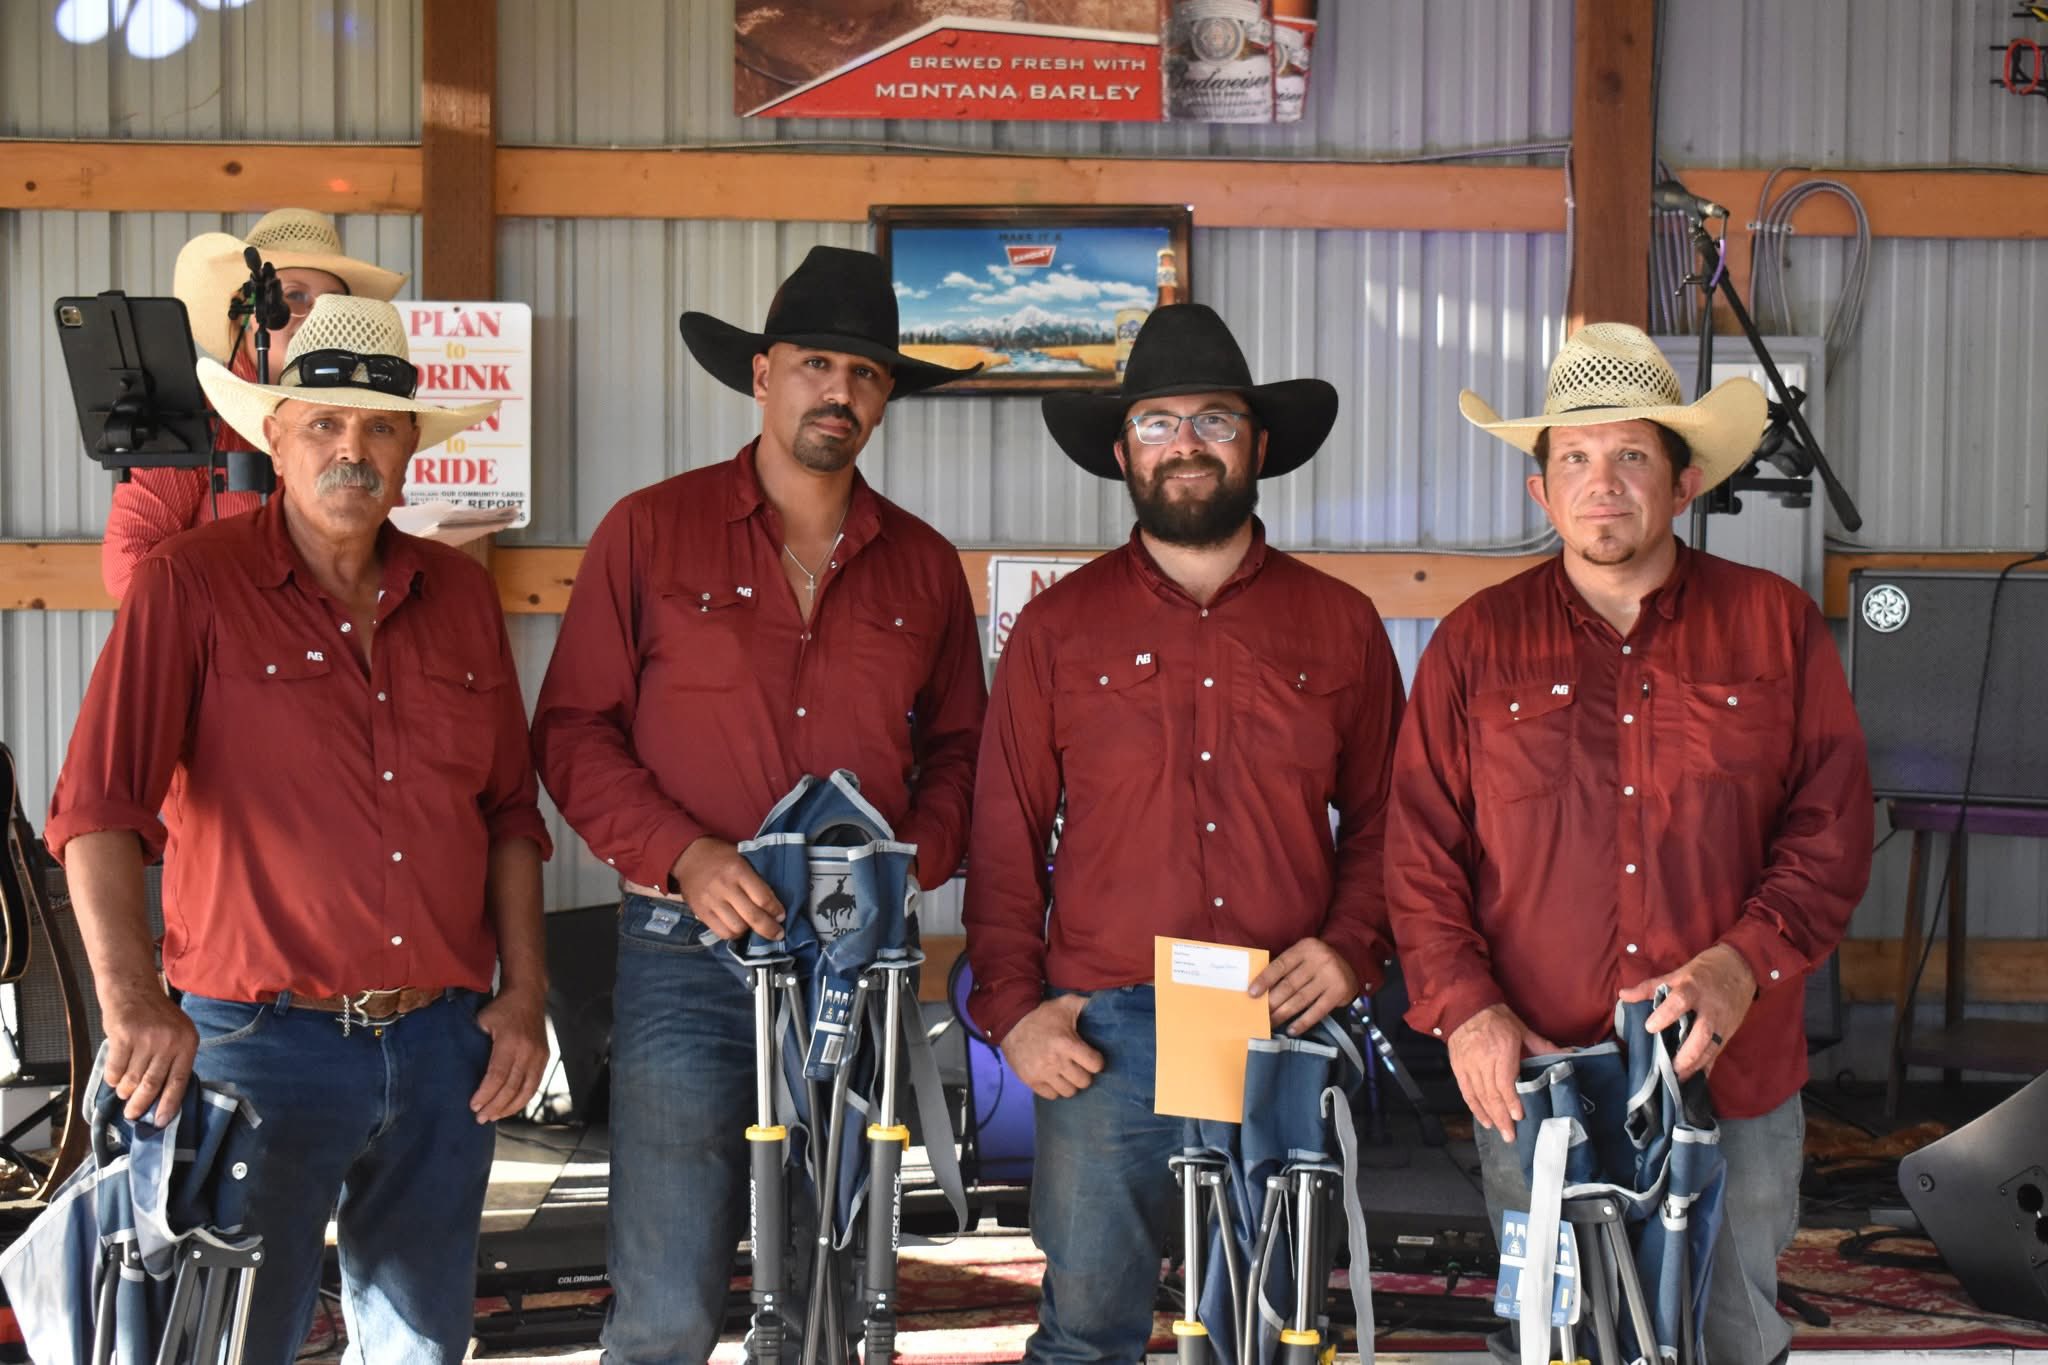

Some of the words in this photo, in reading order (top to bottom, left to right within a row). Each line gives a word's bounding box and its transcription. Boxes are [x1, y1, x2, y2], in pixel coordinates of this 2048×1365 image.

[910, 56, 1001, 70] BREWED
[1011, 58, 1084, 70] FRESH
[1094, 59, 1146, 71] WITH
[875, 83, 1018, 99] MONTANA
[1029, 85, 1141, 100] BARLEY
[410, 310, 502, 337] PLAN
[445, 342, 466, 359] to
[413, 458, 498, 485] RIDE
[468, 500, 524, 509] REPORT
[891, 1173, 901, 1252] KICKBACK
